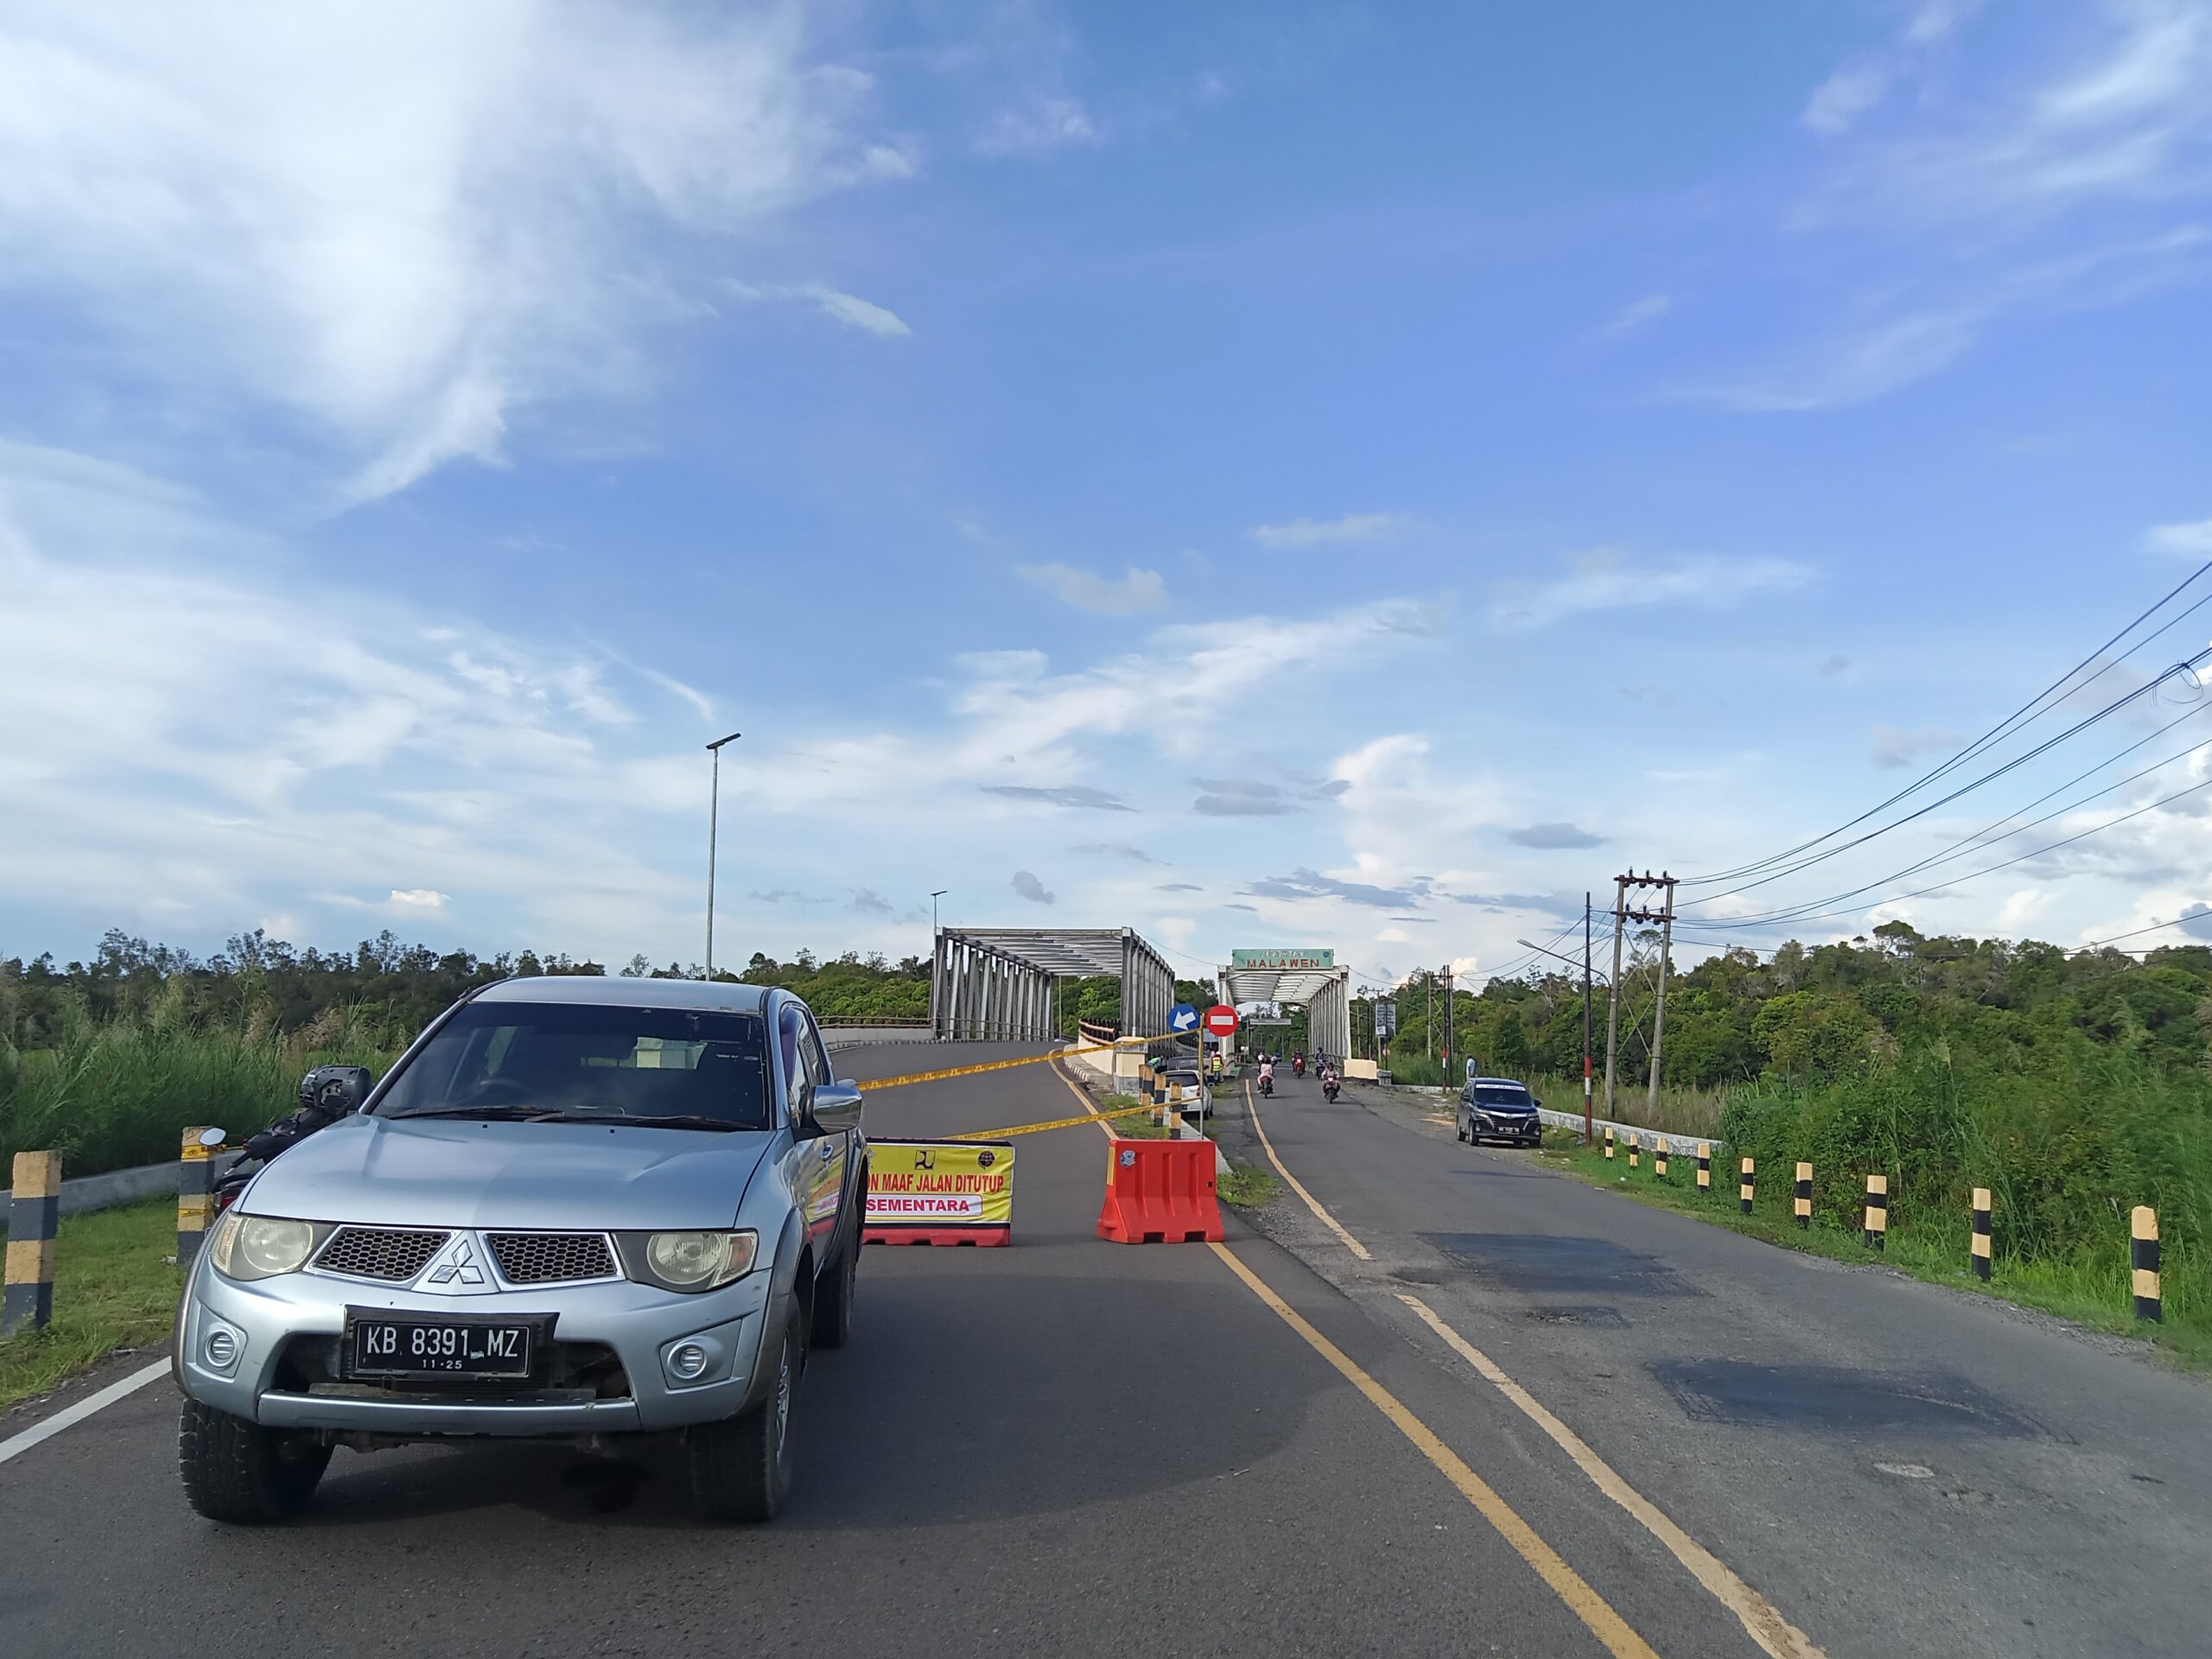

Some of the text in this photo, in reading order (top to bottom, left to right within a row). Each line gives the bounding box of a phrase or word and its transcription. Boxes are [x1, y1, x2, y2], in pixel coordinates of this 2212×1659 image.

[1247, 959, 1319, 968] MALAWEN
[882, 1174, 913, 1192] MAAF
[917, 1175, 952, 1192] JALAN
[956, 1175, 1004, 1193] DITUTUP
[867, 1198, 969, 1212] SEMENTARA
[366, 1326, 518, 1357] KB 8391 MZ
